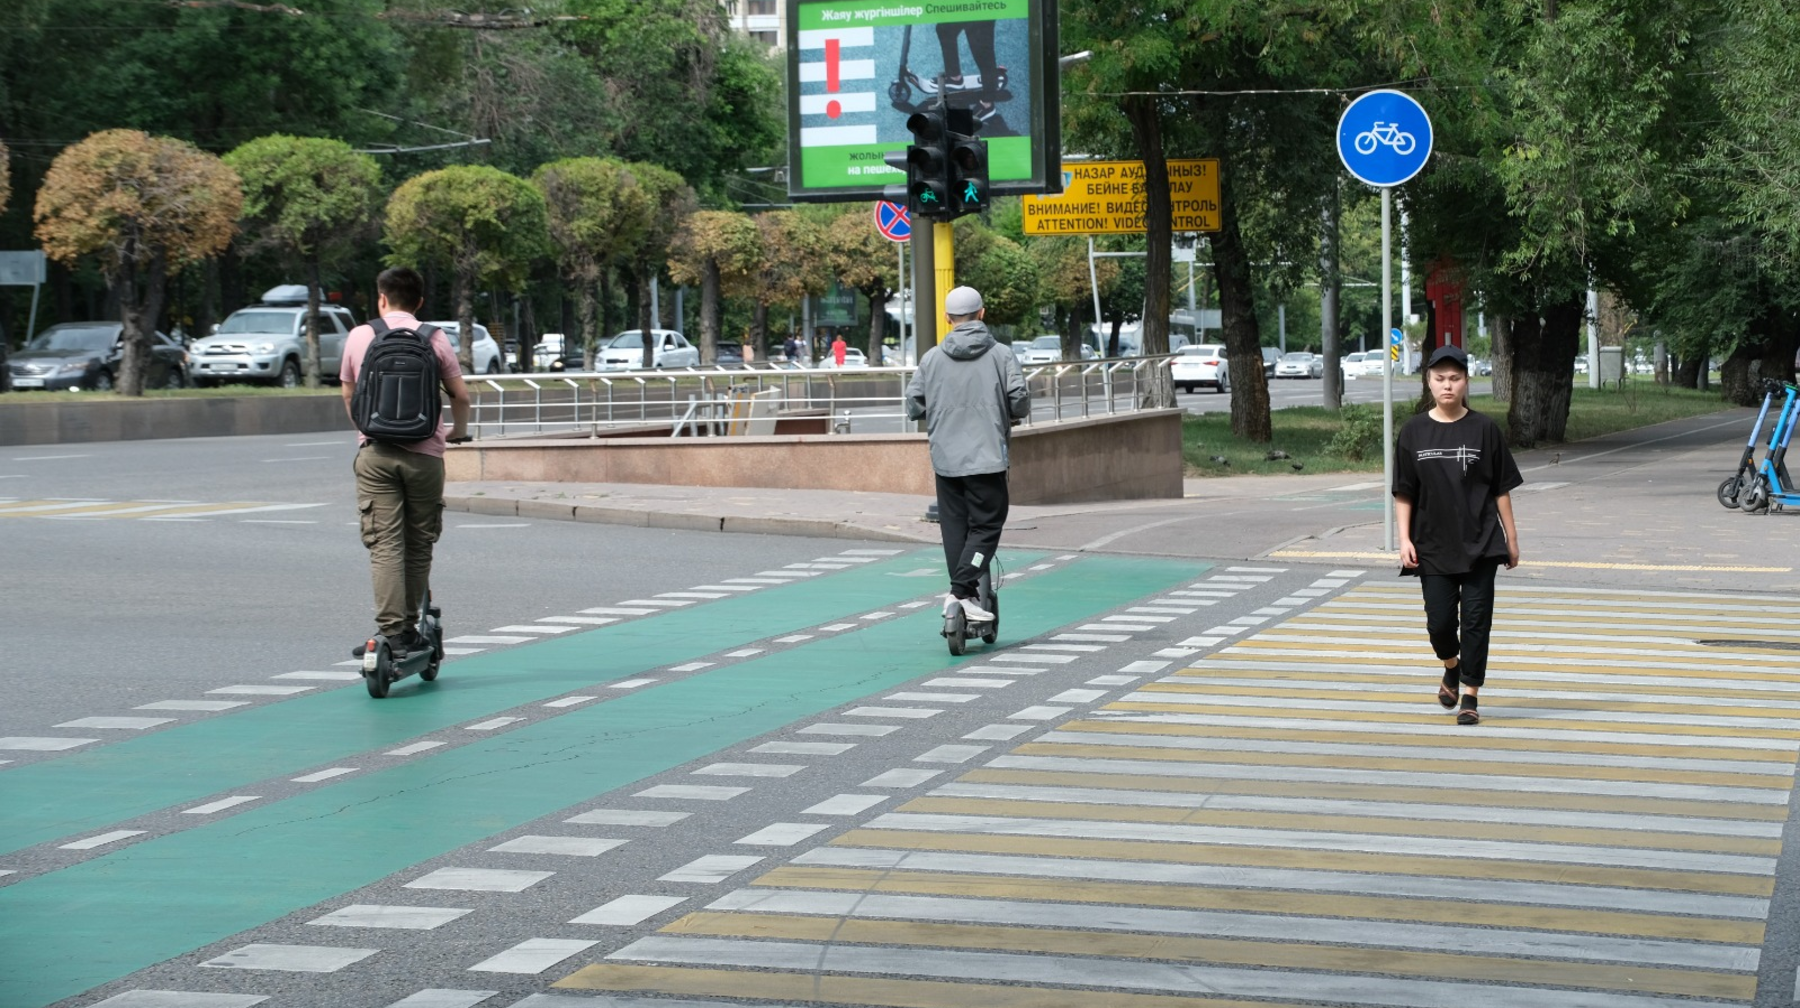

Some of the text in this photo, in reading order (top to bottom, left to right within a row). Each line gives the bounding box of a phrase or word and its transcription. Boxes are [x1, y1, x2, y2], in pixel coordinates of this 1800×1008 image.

[821, 1, 1007, 22] Жаяу жүргіншілер Спешивайтесь
[847, 165, 861, 175] на
[1074, 167, 1116, 179] НАЗАР
[1087, 181, 1129, 195] БЕЙНЕ
[1028, 202, 1101, 216] ВНИМАНИЕ!
[1037, 217, 1108, 231] ATTENTION!
